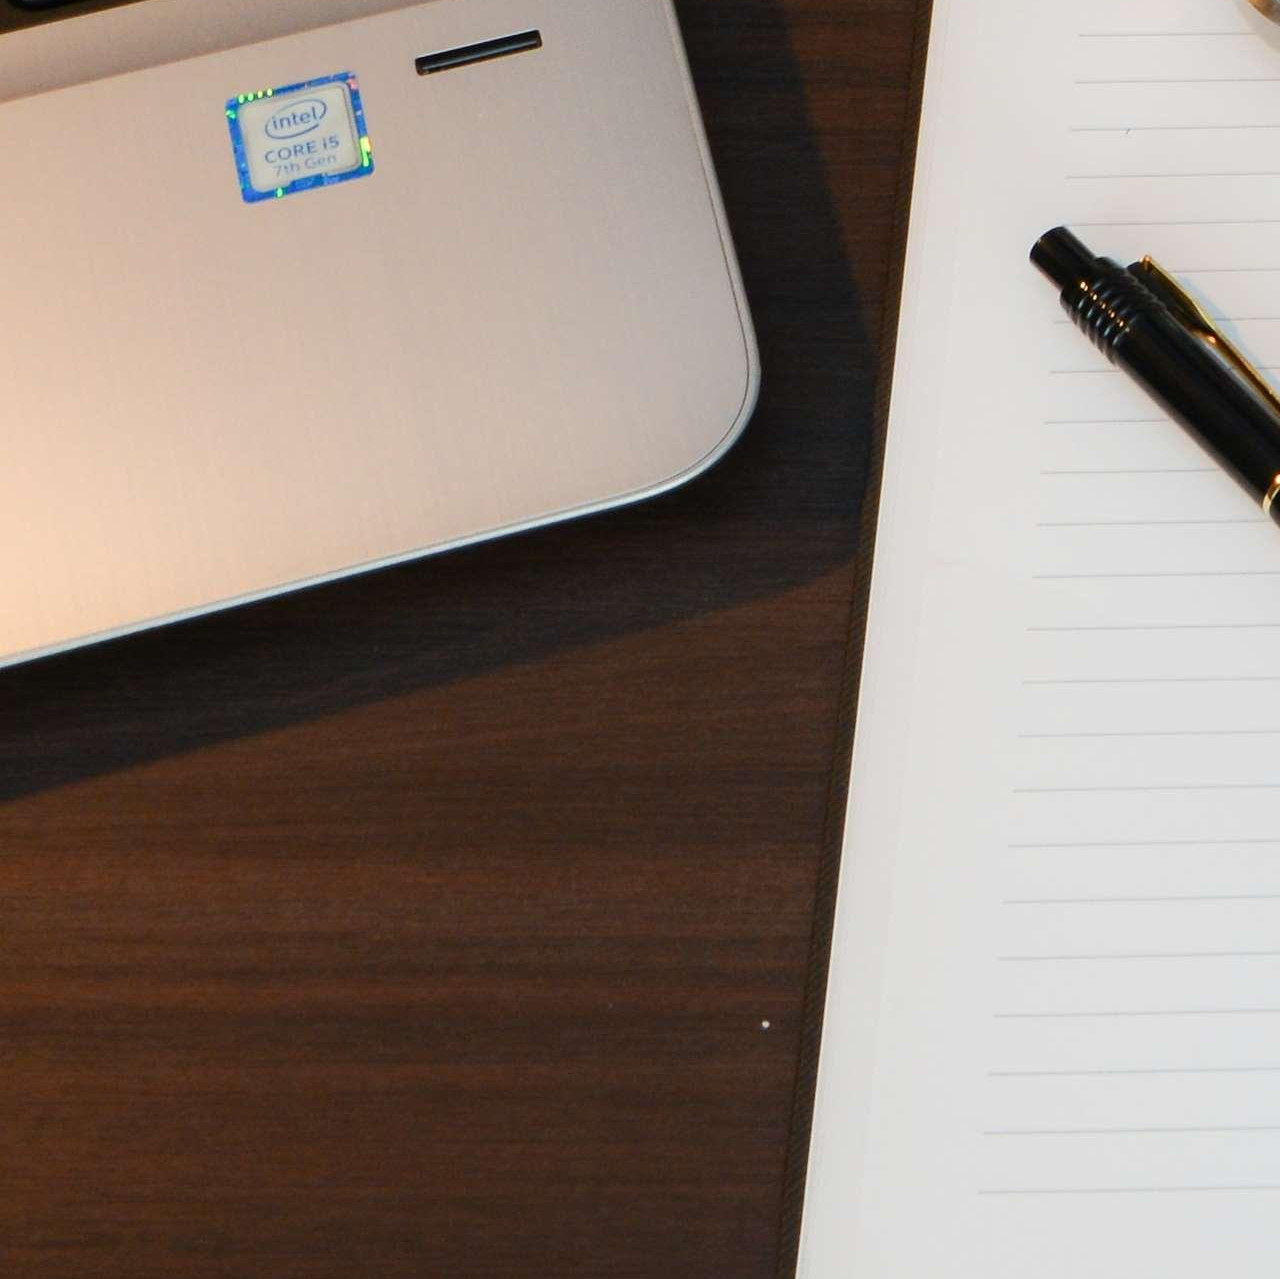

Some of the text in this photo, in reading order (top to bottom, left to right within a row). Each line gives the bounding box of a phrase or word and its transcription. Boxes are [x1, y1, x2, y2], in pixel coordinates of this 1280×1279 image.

[272, 106, 318, 130] intel
[264, 135, 340, 164] CORE i5
[271, 153, 338, 177] 7th Gen
